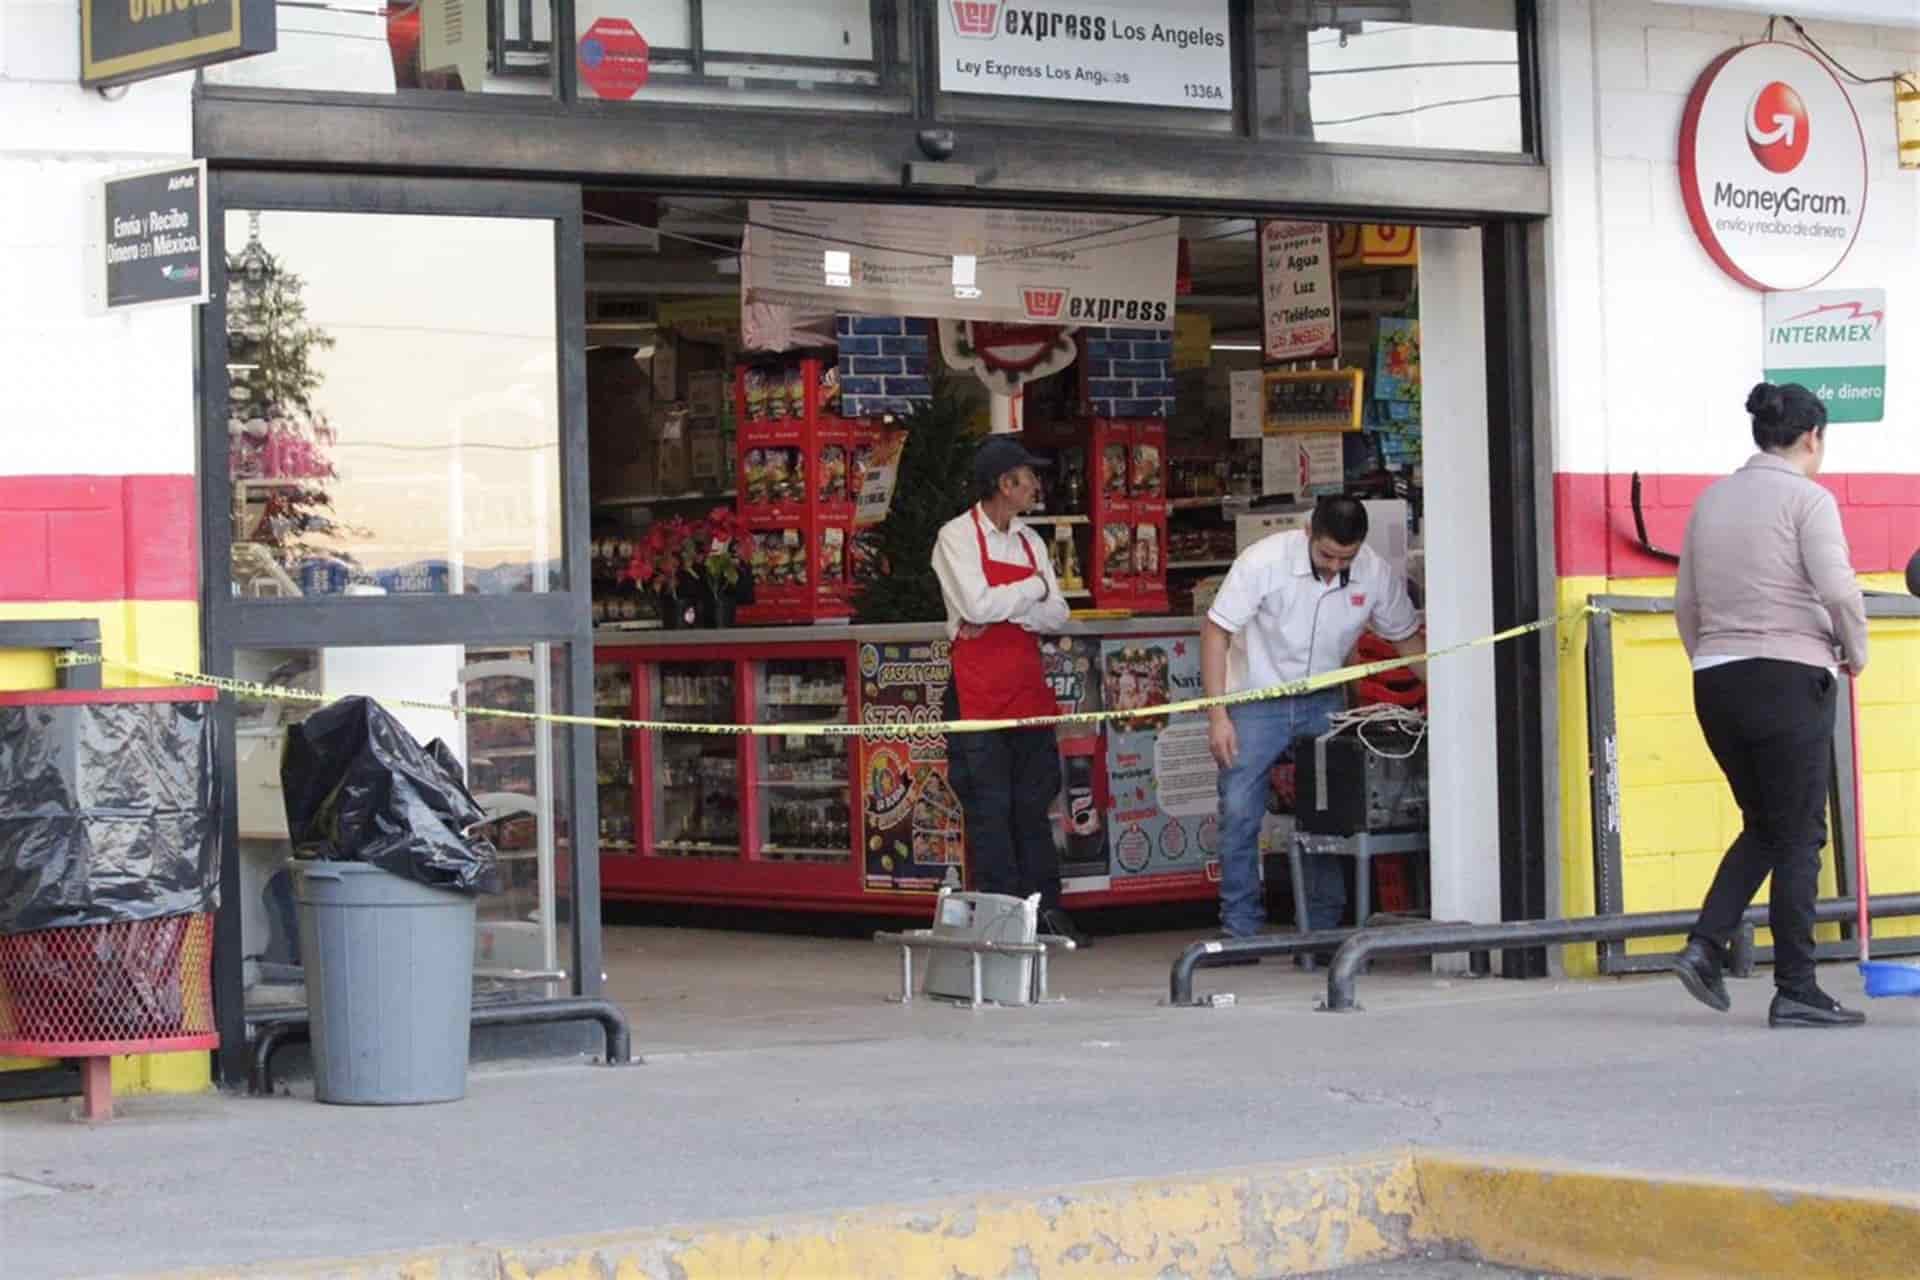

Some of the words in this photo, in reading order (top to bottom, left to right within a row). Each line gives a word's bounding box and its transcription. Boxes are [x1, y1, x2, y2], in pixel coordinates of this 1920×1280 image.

[1005, 9, 1106, 41] express
[1112, 20, 1147, 40] Los
[1151, 23, 1225, 48] Angeles
[956, 59, 981, 75] Ley
[985, 60, 1042, 79] Express
[1046, 66, 1072, 80] Los
[1074, 67, 1131, 85] Anges
[1183, 84, 1224, 100] 1336A
[1714, 181, 1847, 217] MoneyGram
[1758, 218, 1791, 235] recibo
[1792, 221, 1809, 235] de
[1809, 221, 1846, 239] dinero
[140, 241, 153, 258] en
[1288, 254, 1318, 272] Agua
[1294, 280, 1315, 295] Luz
[1069, 297, 1168, 322] express
[1769, 324, 1873, 344] INTERMEX
[1817, 384, 1834, 399] de
[1839, 384, 1882, 399] dinero
